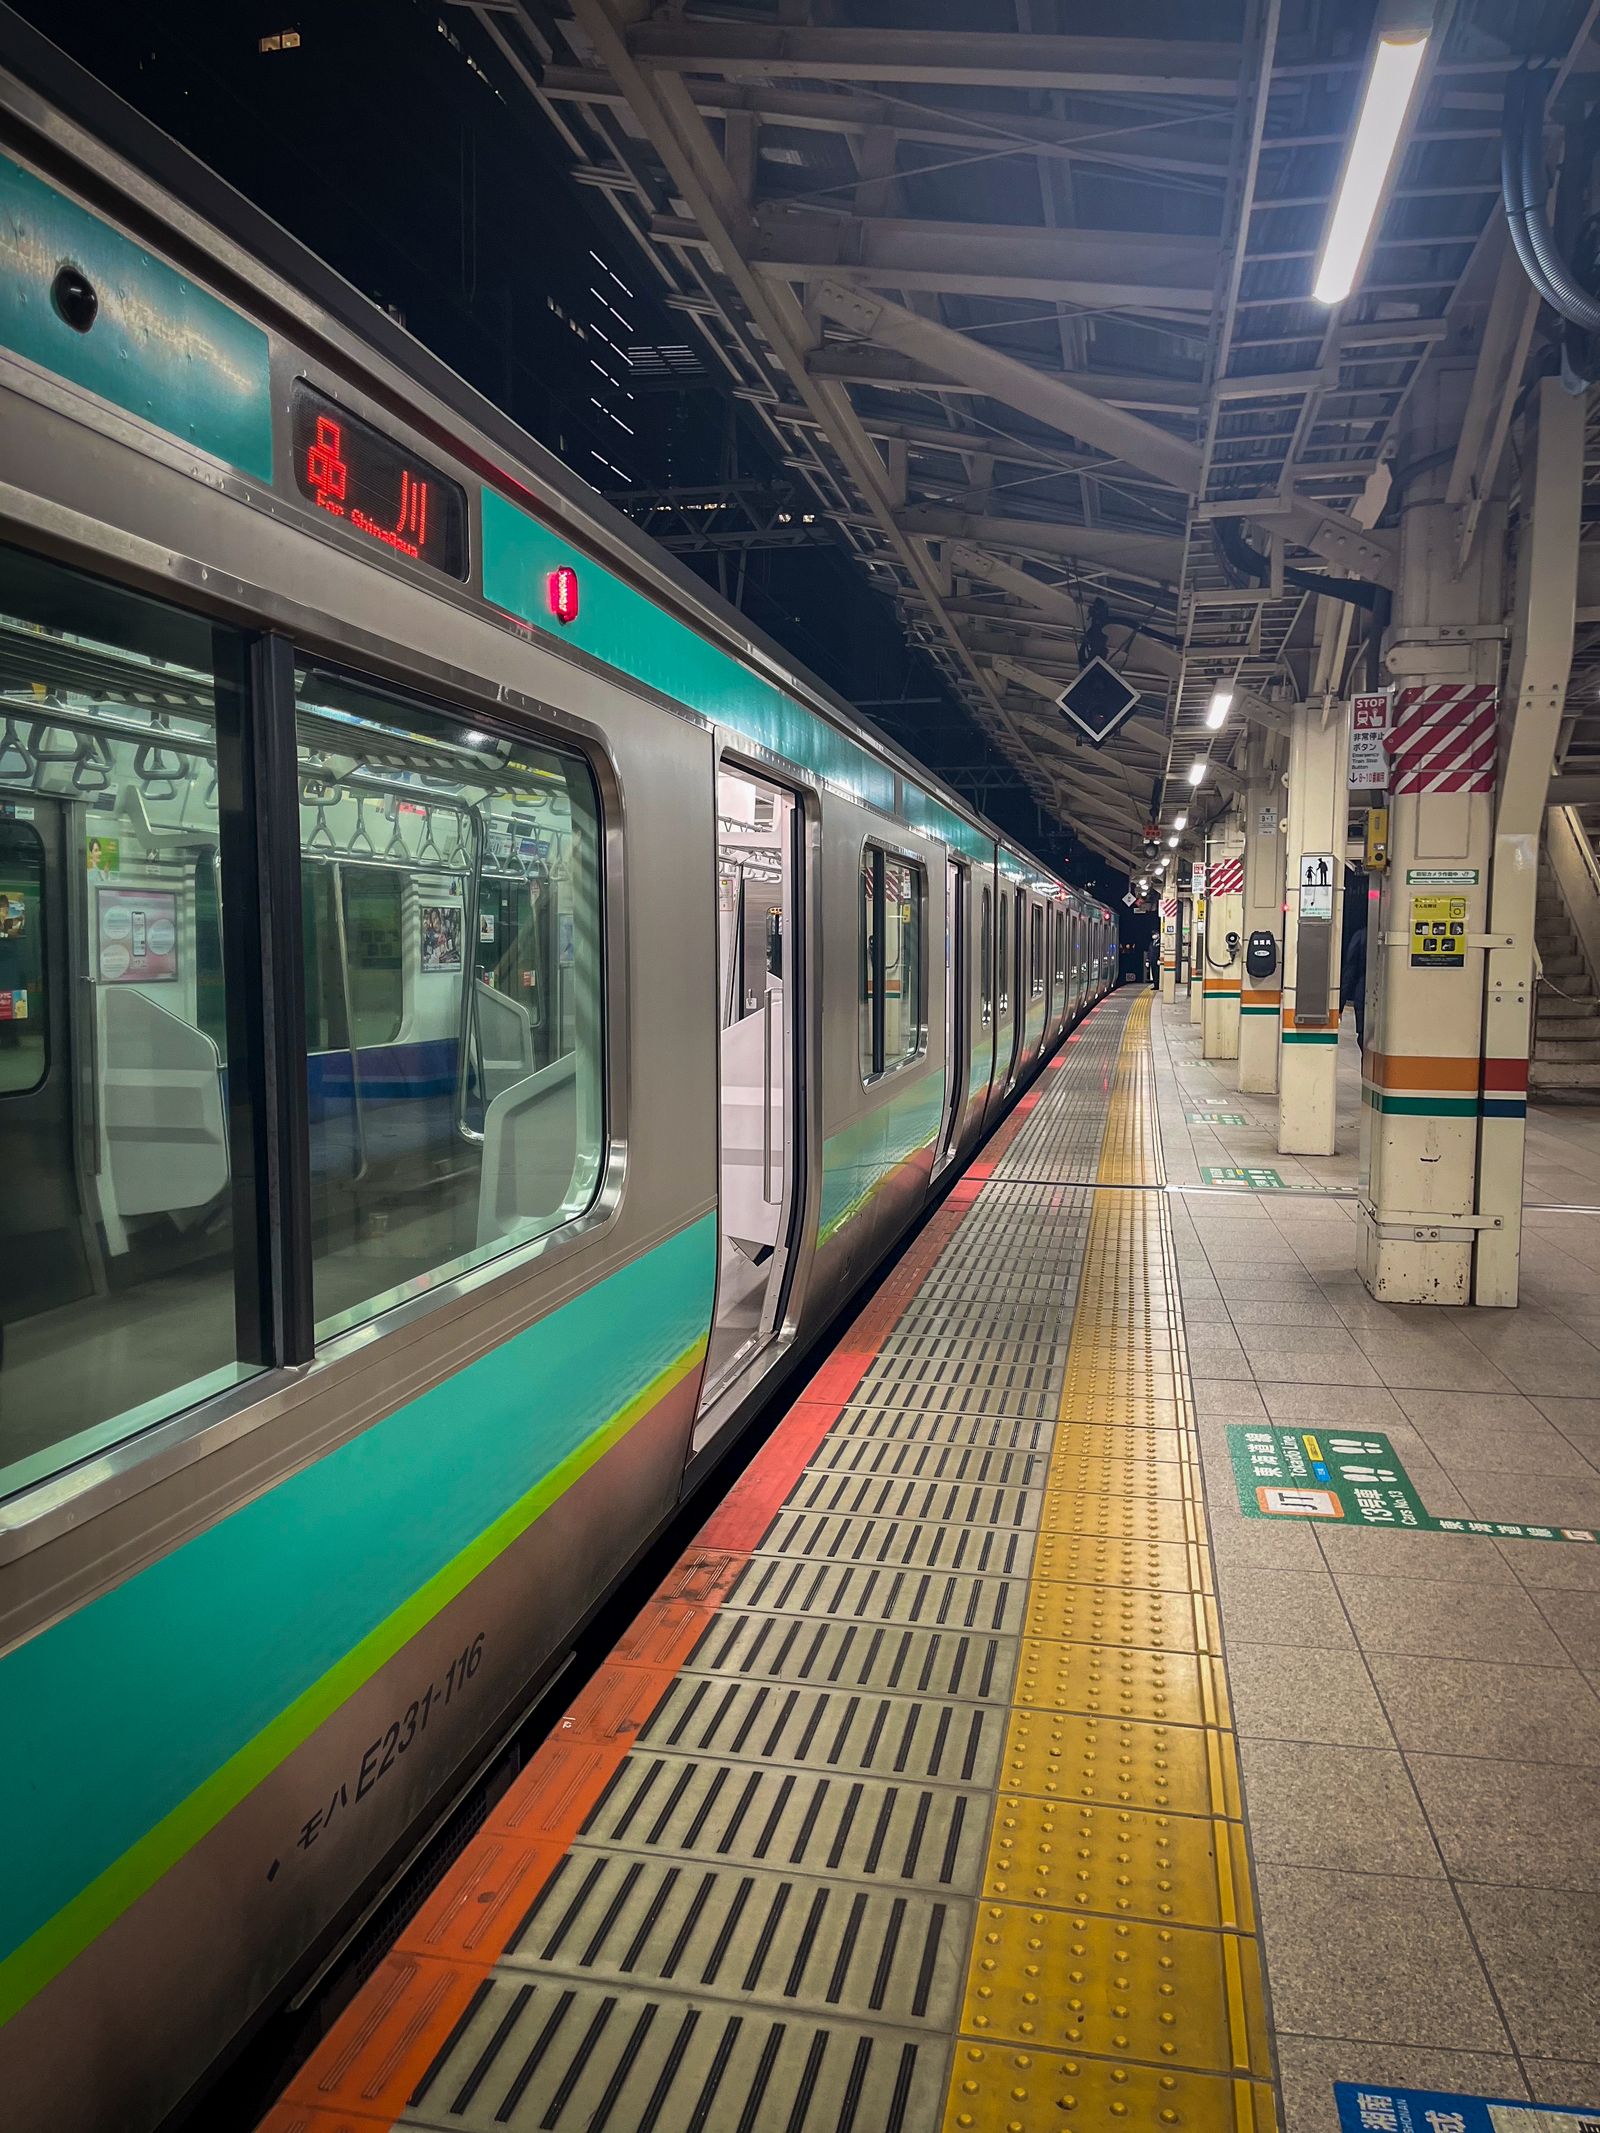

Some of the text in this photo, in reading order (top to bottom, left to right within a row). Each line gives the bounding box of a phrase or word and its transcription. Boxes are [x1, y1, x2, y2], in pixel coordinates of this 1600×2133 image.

[307, 415, 427, 545] 品川
[315, 489, 418, 559] For Shinagawa
[1356, 698, 1385, 709] STOP
[1353, 732, 1384, 741] 非常停止
[1353, 743, 1377, 751] ボタン
[1280, 1435, 1299, 1450] Line
[1244, 1432, 1283, 1477] 東海道線
[1278, 1492, 1318, 1511] JT
[1353, 1488, 1395, 1523] 13号車
[1439, 1519, 1554, 1538] 東海道線
[1357, 2092, 1398, 2132] 湘南
